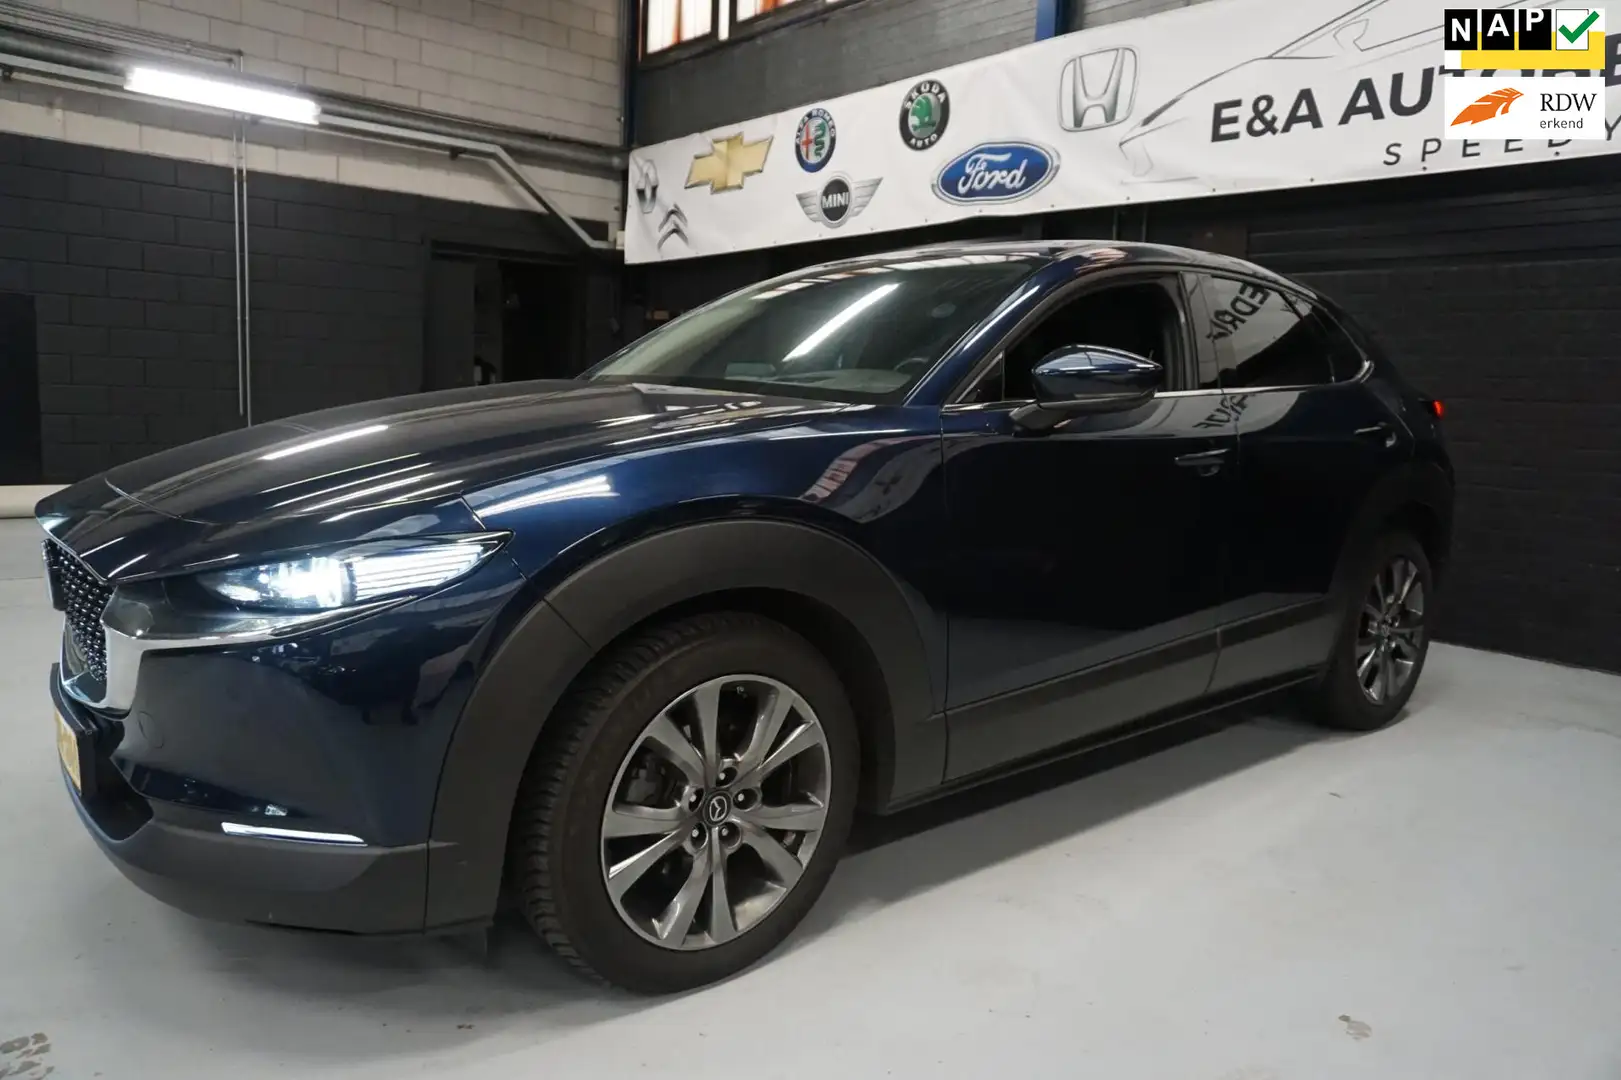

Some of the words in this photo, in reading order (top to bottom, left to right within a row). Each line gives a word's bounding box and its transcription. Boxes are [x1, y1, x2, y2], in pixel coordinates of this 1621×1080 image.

[1211, 88, 1324, 142] E&A
[910, 133, 938, 149] AUTO
[957, 152, 1028, 194] Ford
[821, 192, 850, 209] MINI
